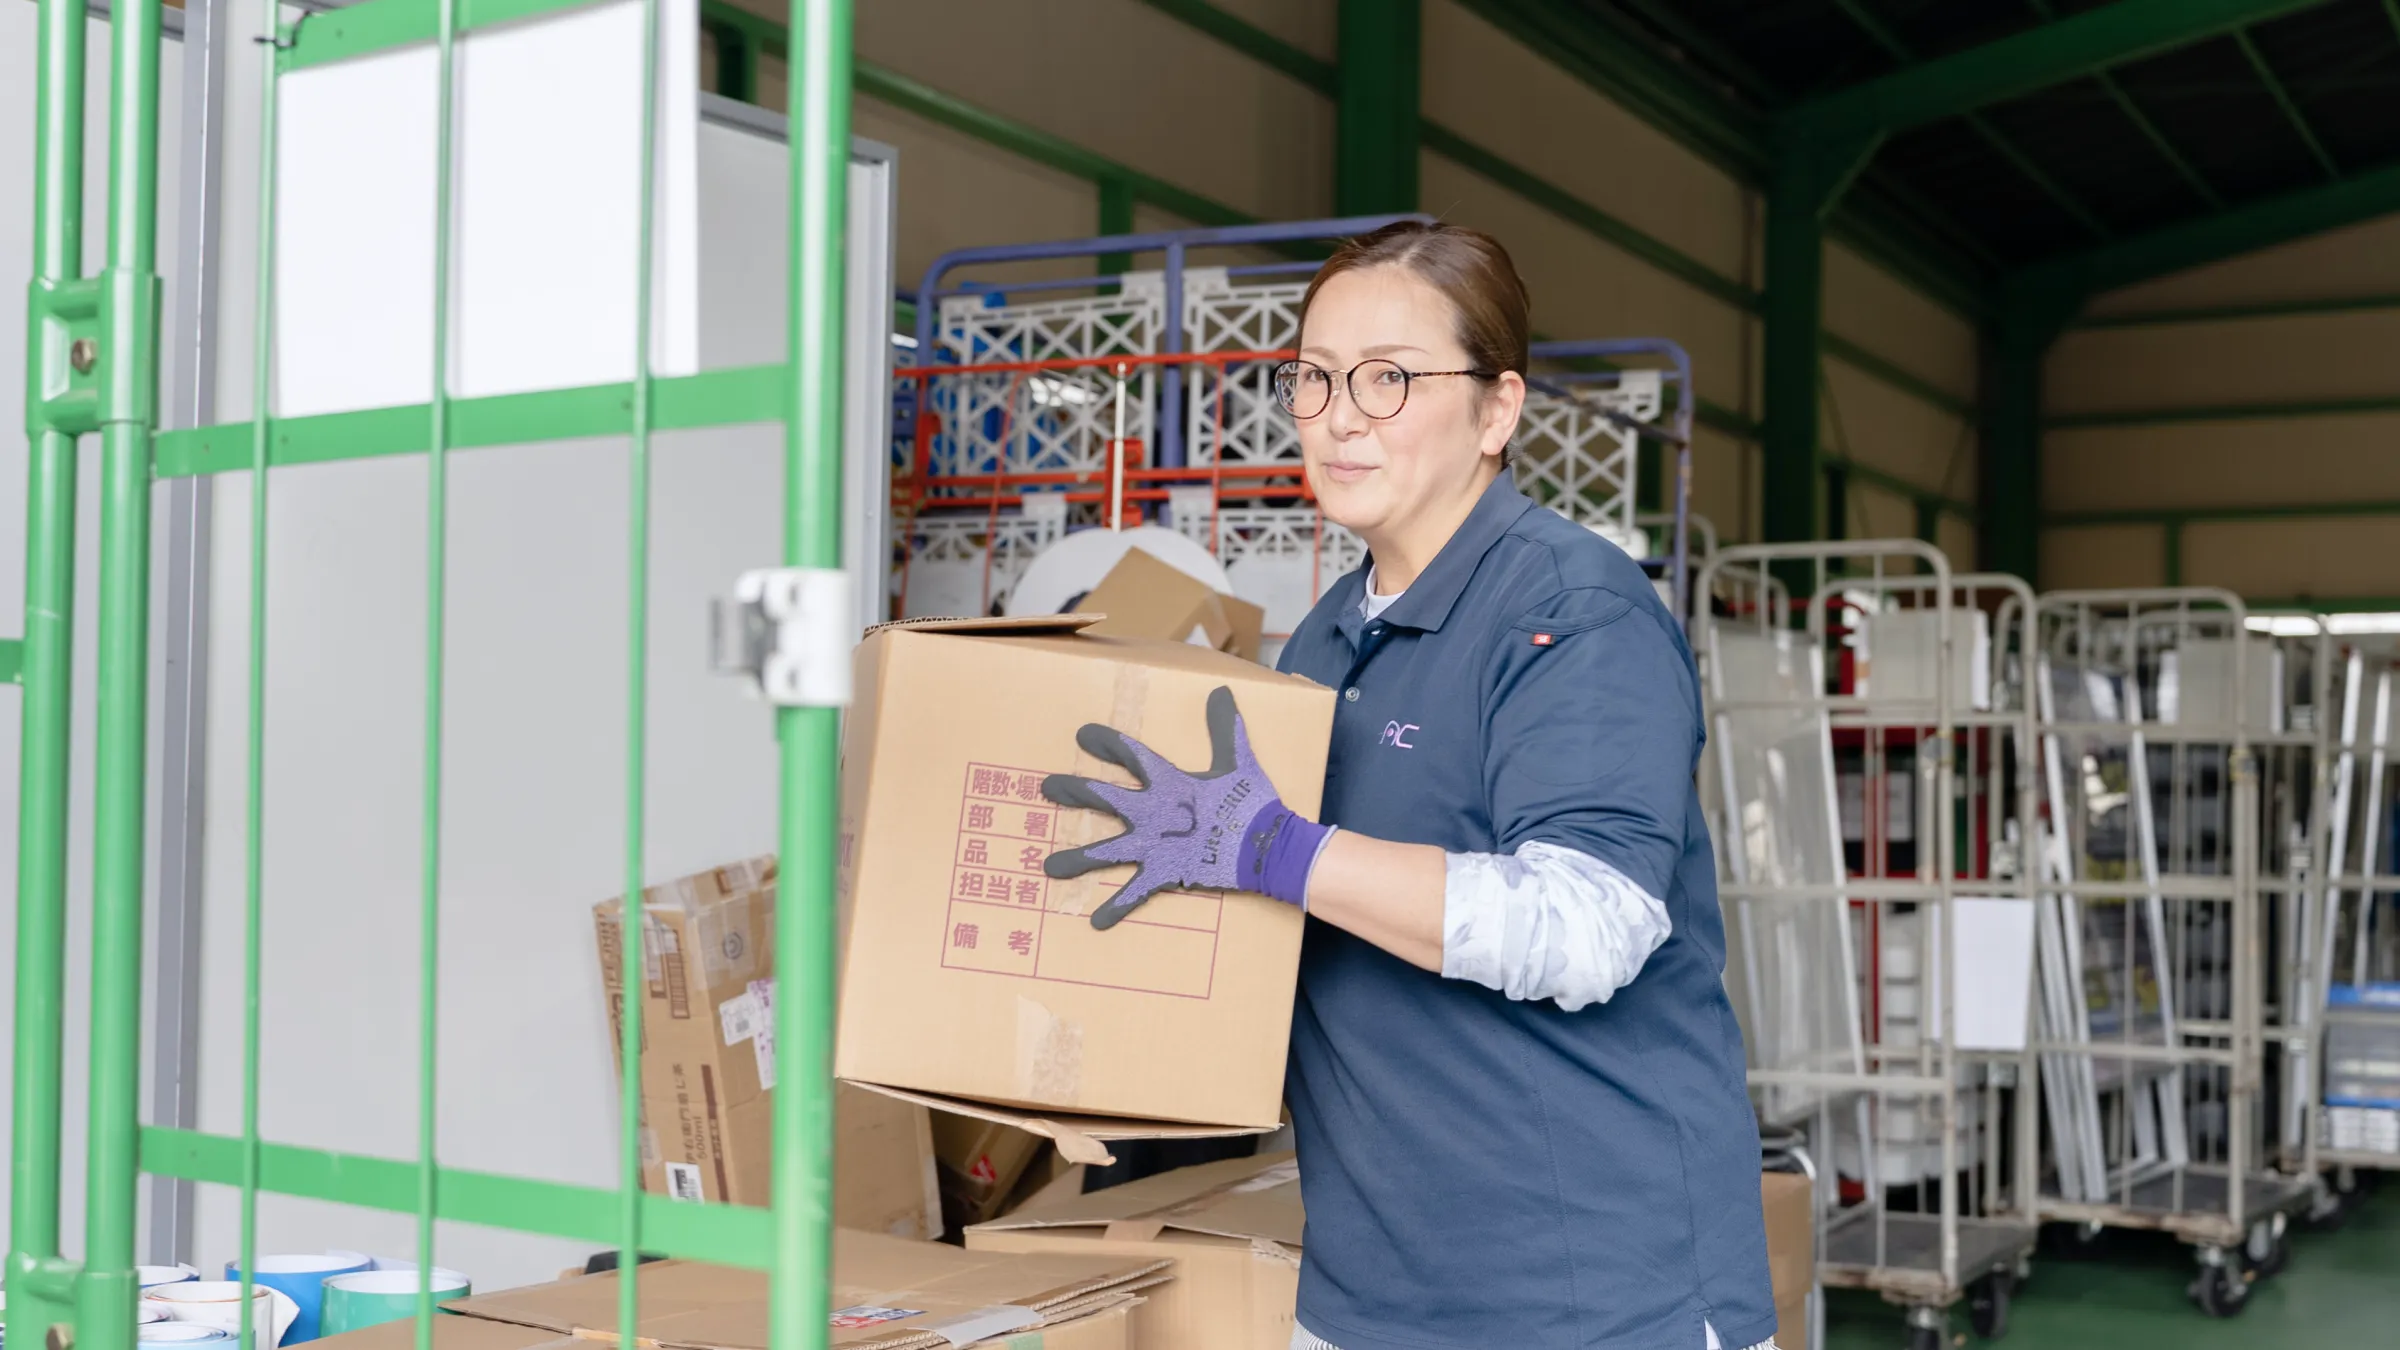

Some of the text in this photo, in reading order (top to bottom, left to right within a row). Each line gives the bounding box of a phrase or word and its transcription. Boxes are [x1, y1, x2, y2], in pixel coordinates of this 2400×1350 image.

[968, 804, 1049, 837] 部署
[963, 839, 1044, 871] 品名
[1201, 825, 1223, 865] Lite
[958, 872, 1040, 904] 担当者
[953, 923, 1033, 956] 備考
